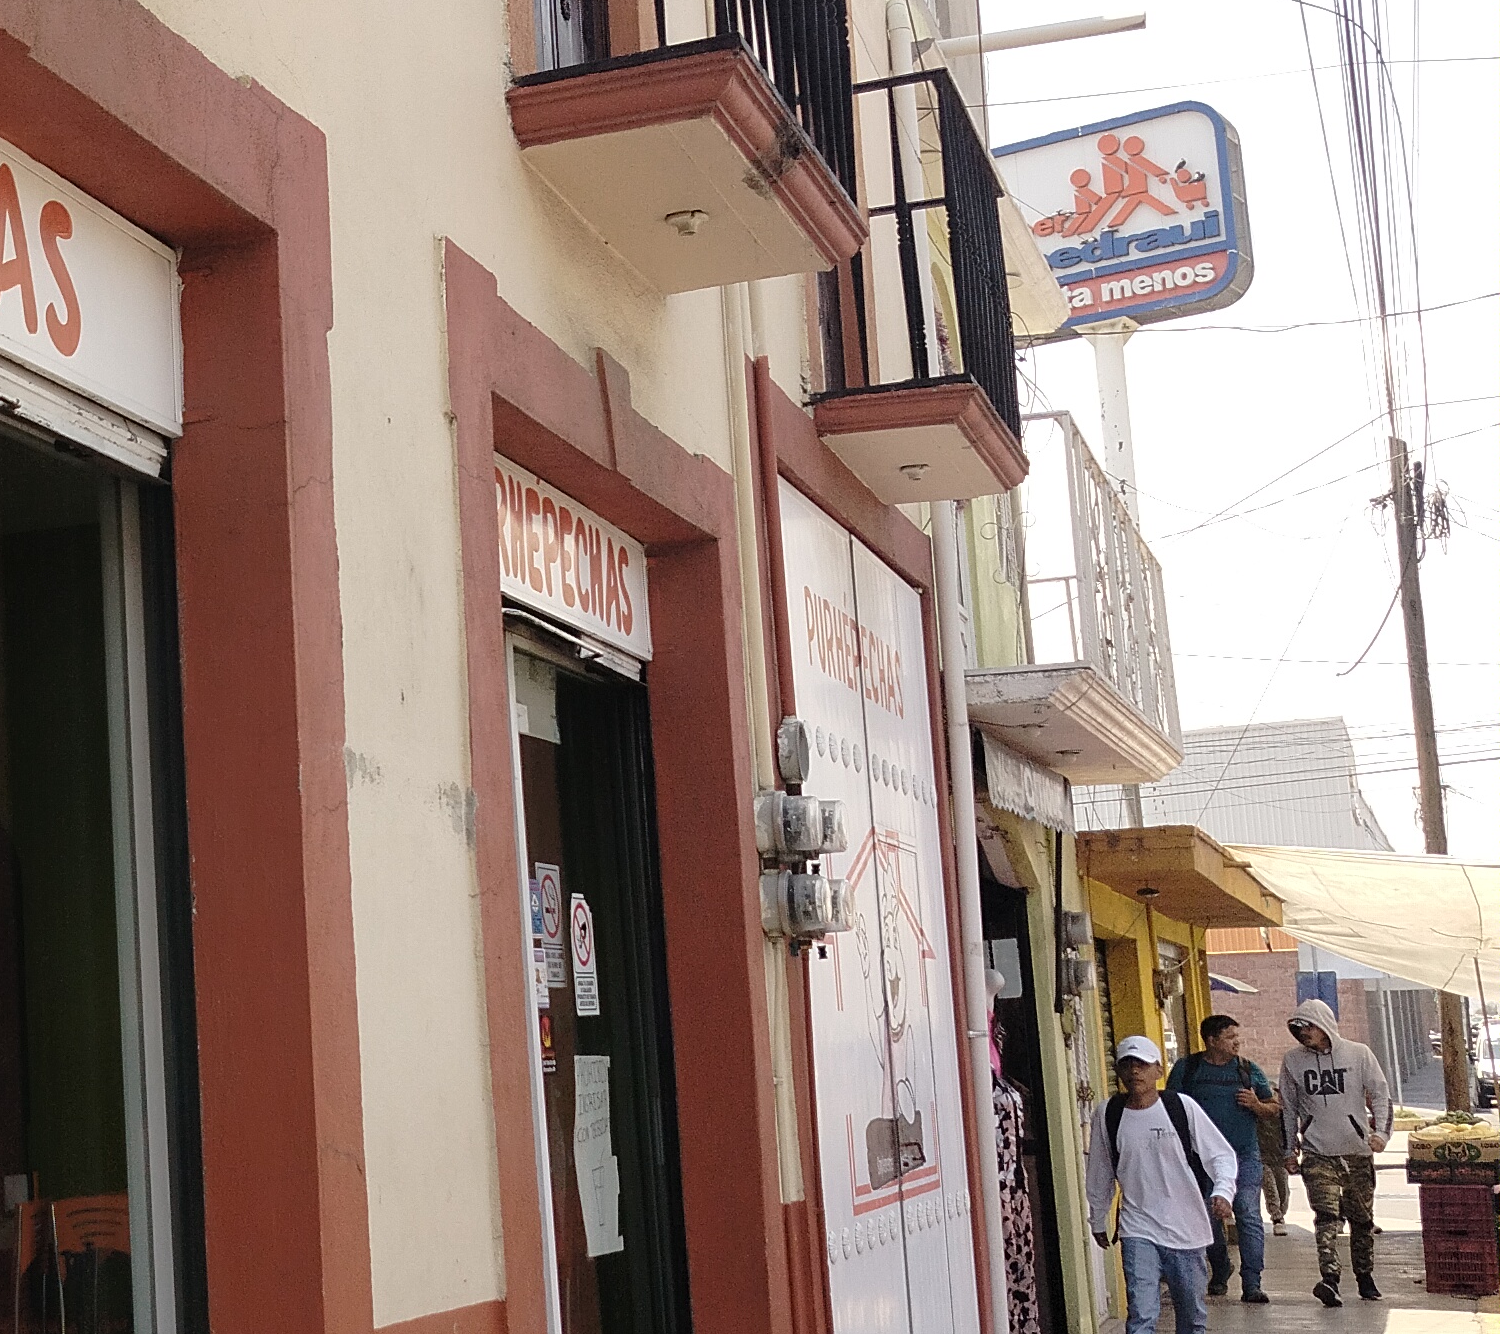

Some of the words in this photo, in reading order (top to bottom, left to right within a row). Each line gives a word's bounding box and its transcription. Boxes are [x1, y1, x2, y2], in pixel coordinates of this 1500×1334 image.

[1101, 261, 1215, 303] menos
[803, 585, 904, 720] PURHÉPECHAS
[1304, 1067, 1348, 1096] CAT
